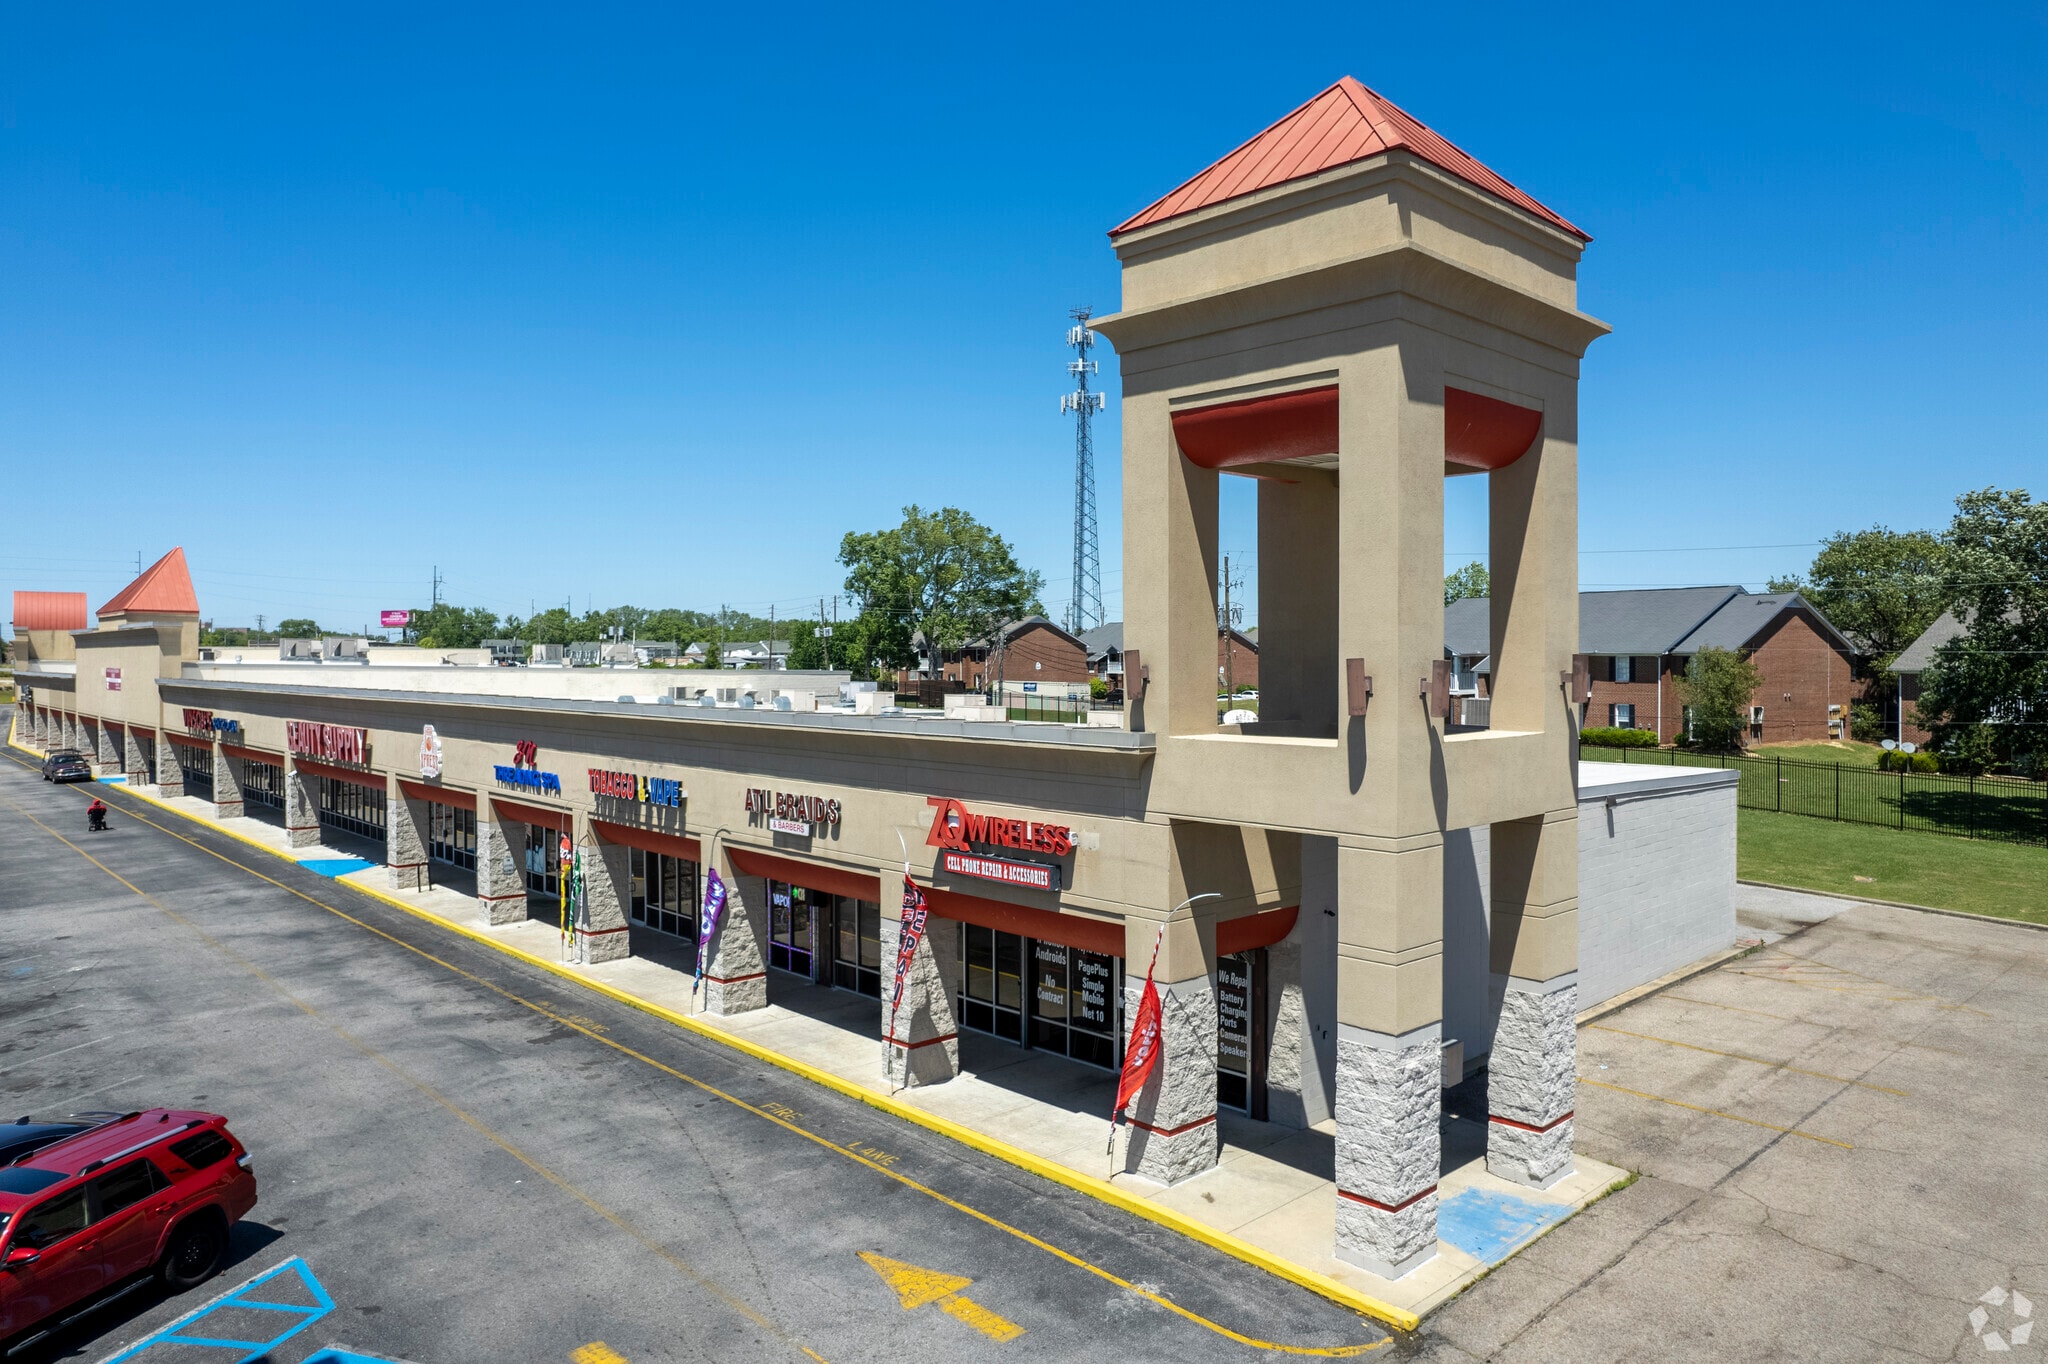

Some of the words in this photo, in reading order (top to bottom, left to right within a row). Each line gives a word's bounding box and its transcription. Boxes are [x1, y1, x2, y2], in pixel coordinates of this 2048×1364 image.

[286, 721, 322, 755] BEAUTY
[323, 725, 367, 763] SUPPLY
[493, 765, 541, 787] THREADING
[541, 772, 561, 791] SPA
[588, 768, 636, 800] TOBACCO
[638, 776, 647, 802] &
[650, 777, 680, 808] VAPE
[745, 788, 773, 814] ATL
[776, 792, 839, 825] BRAIDS
[777, 822, 805, 833] BARBERS
[926, 796, 970, 852] ZQ
[966, 813, 1072, 857] WIRELESS
[947, 856, 960, 871] CELL
[961, 858, 980, 875] PHONE
[981, 861, 1002, 878] REPAIR
[1003, 865, 1008, 879] &
[1008, 865, 1049, 886] ACCESSORIES
[1035, 947, 1067, 965] Androids
[1078, 960, 1109, 977] PagePlus
[1045, 974, 1056, 988] No
[1082, 977, 1104, 993] Simple
[1218, 969, 1229, 984] We
[1230, 972, 1248, 989] Repai
[1037, 987, 1063, 1005] Contract
[1082, 990, 1104, 1006] Mobile
[1220, 990, 1244, 1007] Battery
[1082, 1006, 1094, 1020] Net
[1096, 1010, 1104, 1022] 10
[1220, 1003, 1247, 1020] Charging
[1220, 1015, 1237, 1028] Ports
[759, 1102, 804, 1121] FIRE
[846, 1141, 900, 1166] LANE
